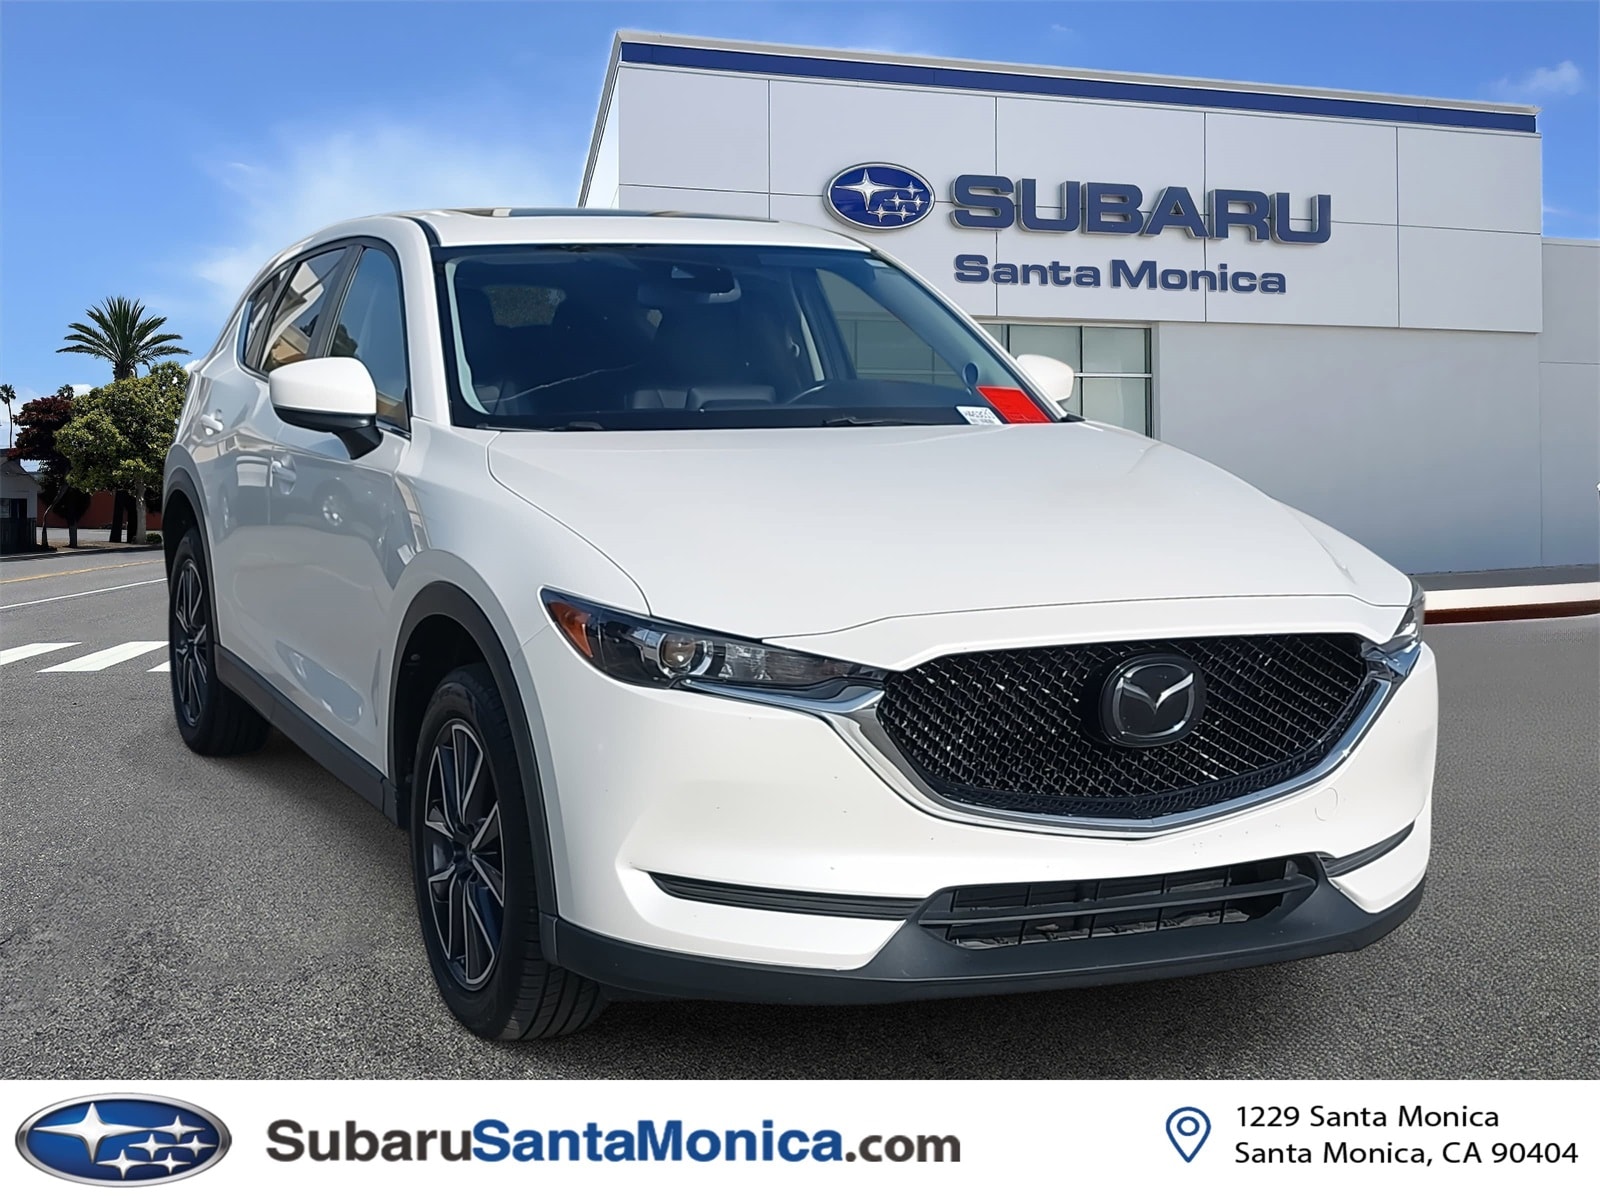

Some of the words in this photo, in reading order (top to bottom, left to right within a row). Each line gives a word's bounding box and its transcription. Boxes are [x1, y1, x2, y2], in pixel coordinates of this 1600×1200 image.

[950, 174, 1332, 244] SUBARU
[954, 254, 1101, 288] Santa
[1110, 259, 1287, 294] Monica
